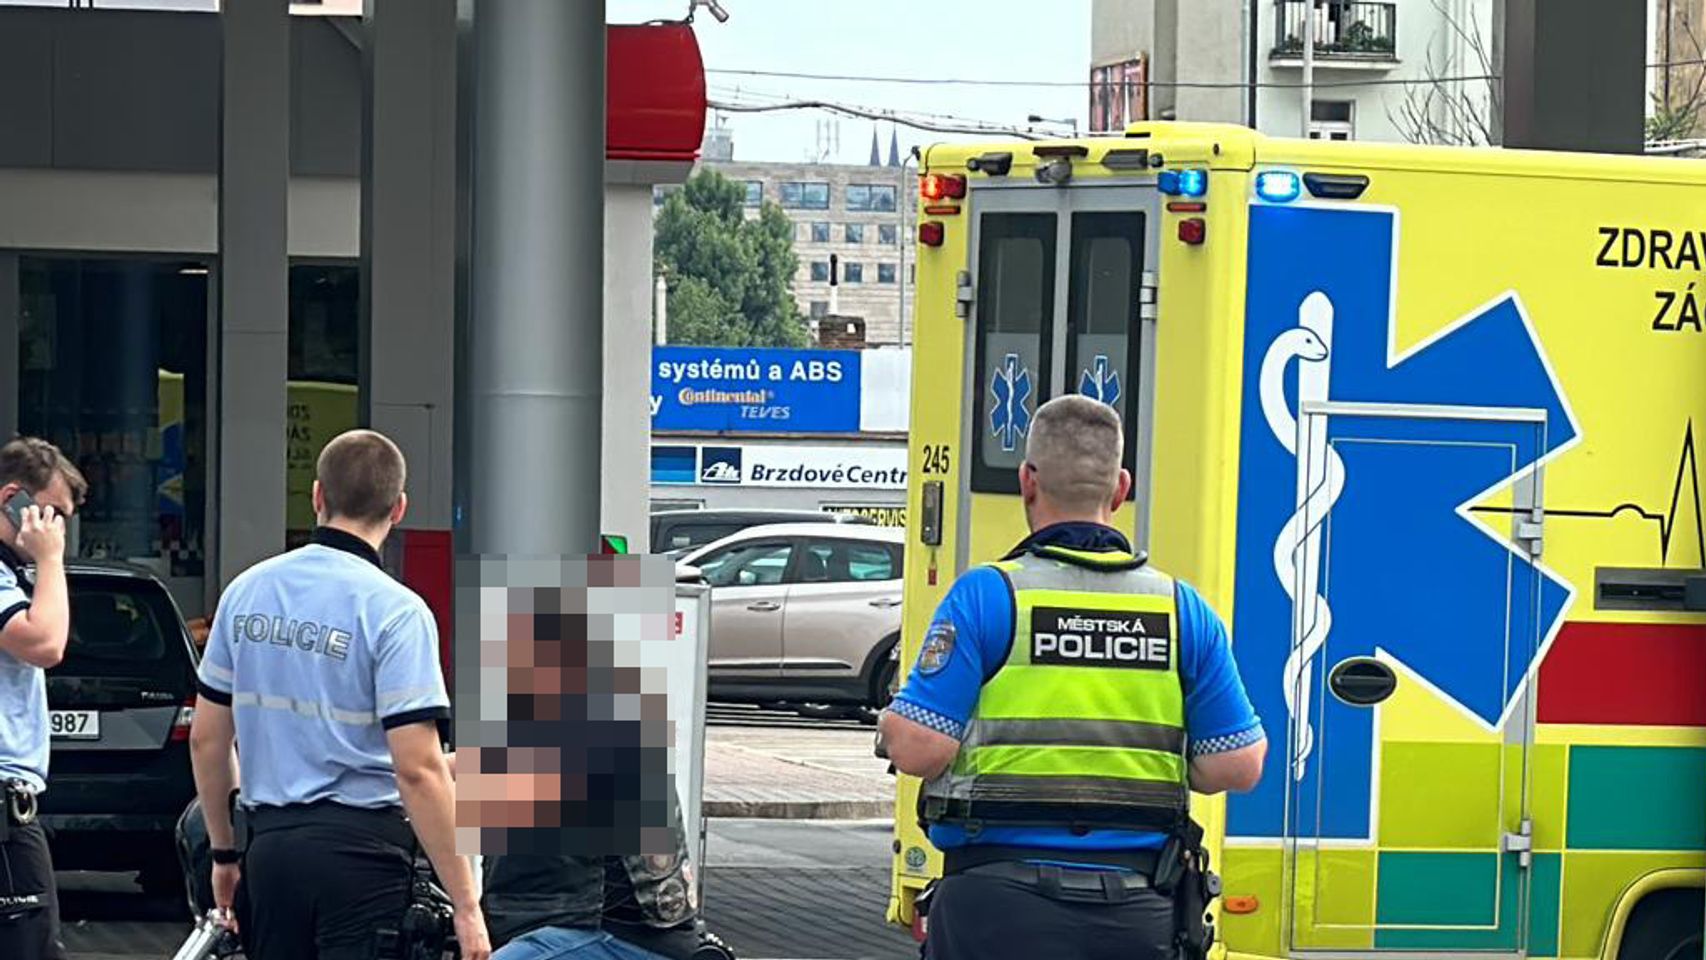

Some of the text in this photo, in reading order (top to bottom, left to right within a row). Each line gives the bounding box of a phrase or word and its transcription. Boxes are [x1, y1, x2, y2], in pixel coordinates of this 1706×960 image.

[658, 358, 842, 382] systémů a ABS
[740, 405, 790, 419] TEVES
[922, 445, 950, 473] 245
[1057, 615, 1145, 634] MĚSTSKÁ
[1034, 633, 1169, 662] POLICIE
[51, 713, 89, 733] 987
